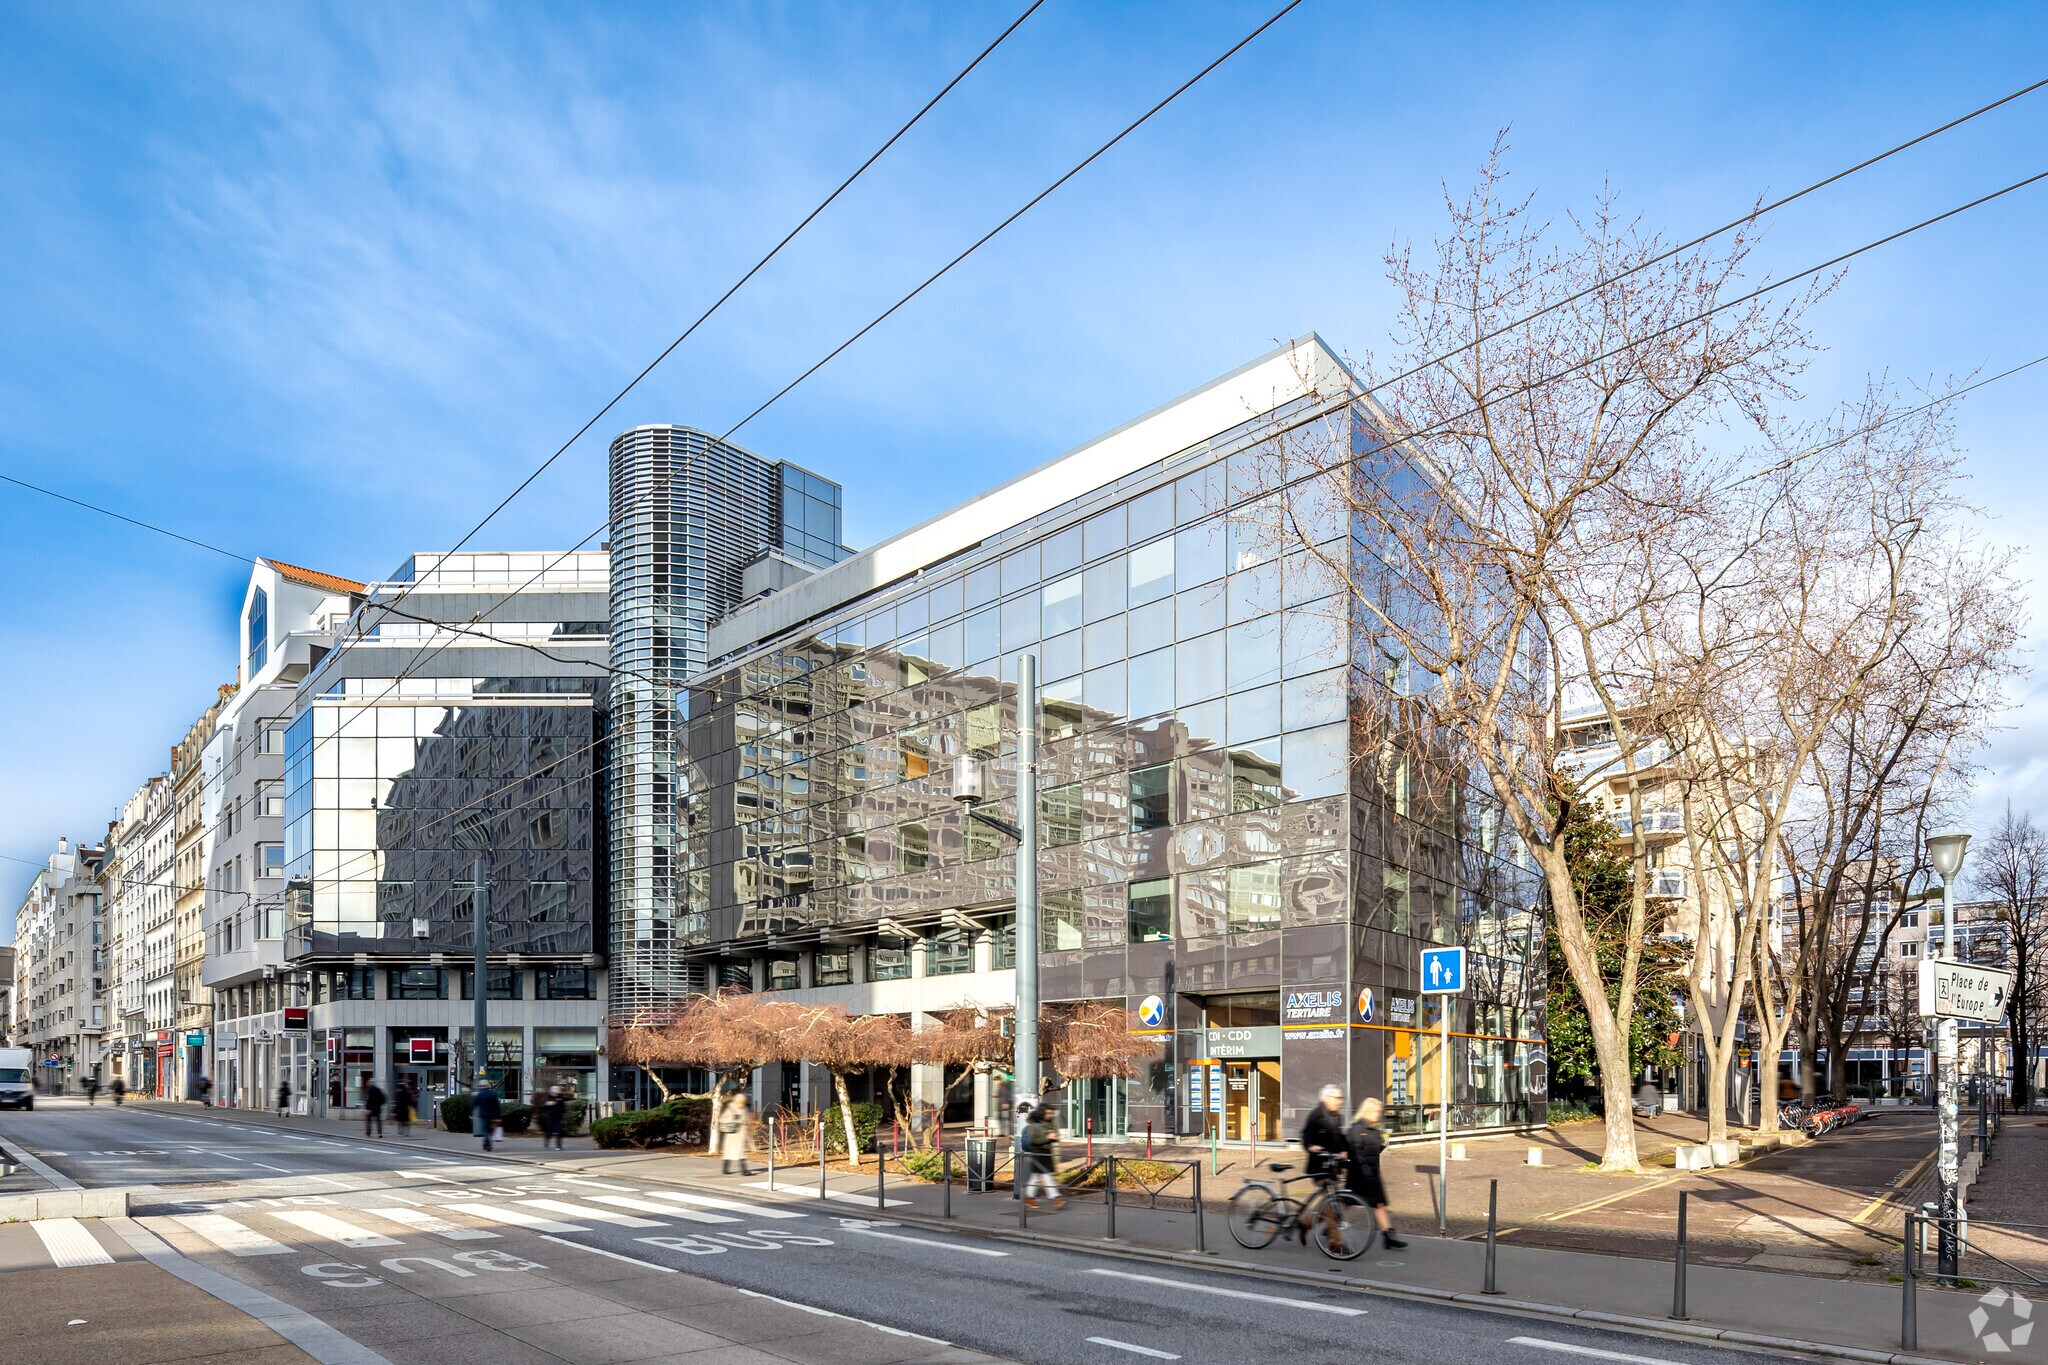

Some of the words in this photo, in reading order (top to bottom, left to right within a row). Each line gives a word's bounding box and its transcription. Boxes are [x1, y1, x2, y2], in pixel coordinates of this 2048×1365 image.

[1951, 972, 1973, 989] Place
[1977, 977, 1989, 991] de
[1286, 991, 1342, 1008] AXELIS
[1390, 997, 1415, 1014] AXELIS
[1951, 993, 1985, 1015] l'Europe
[1286, 1007, 1332, 1018] TERTIAIRE
[1208, 1031, 1220, 1041] CDI
[1228, 1030, 1252, 1041] CDD
[424, 1185, 570, 1200] BUS
[632, 1230, 835, 1255] BUS
[300, 1249, 550, 1288] BUS
